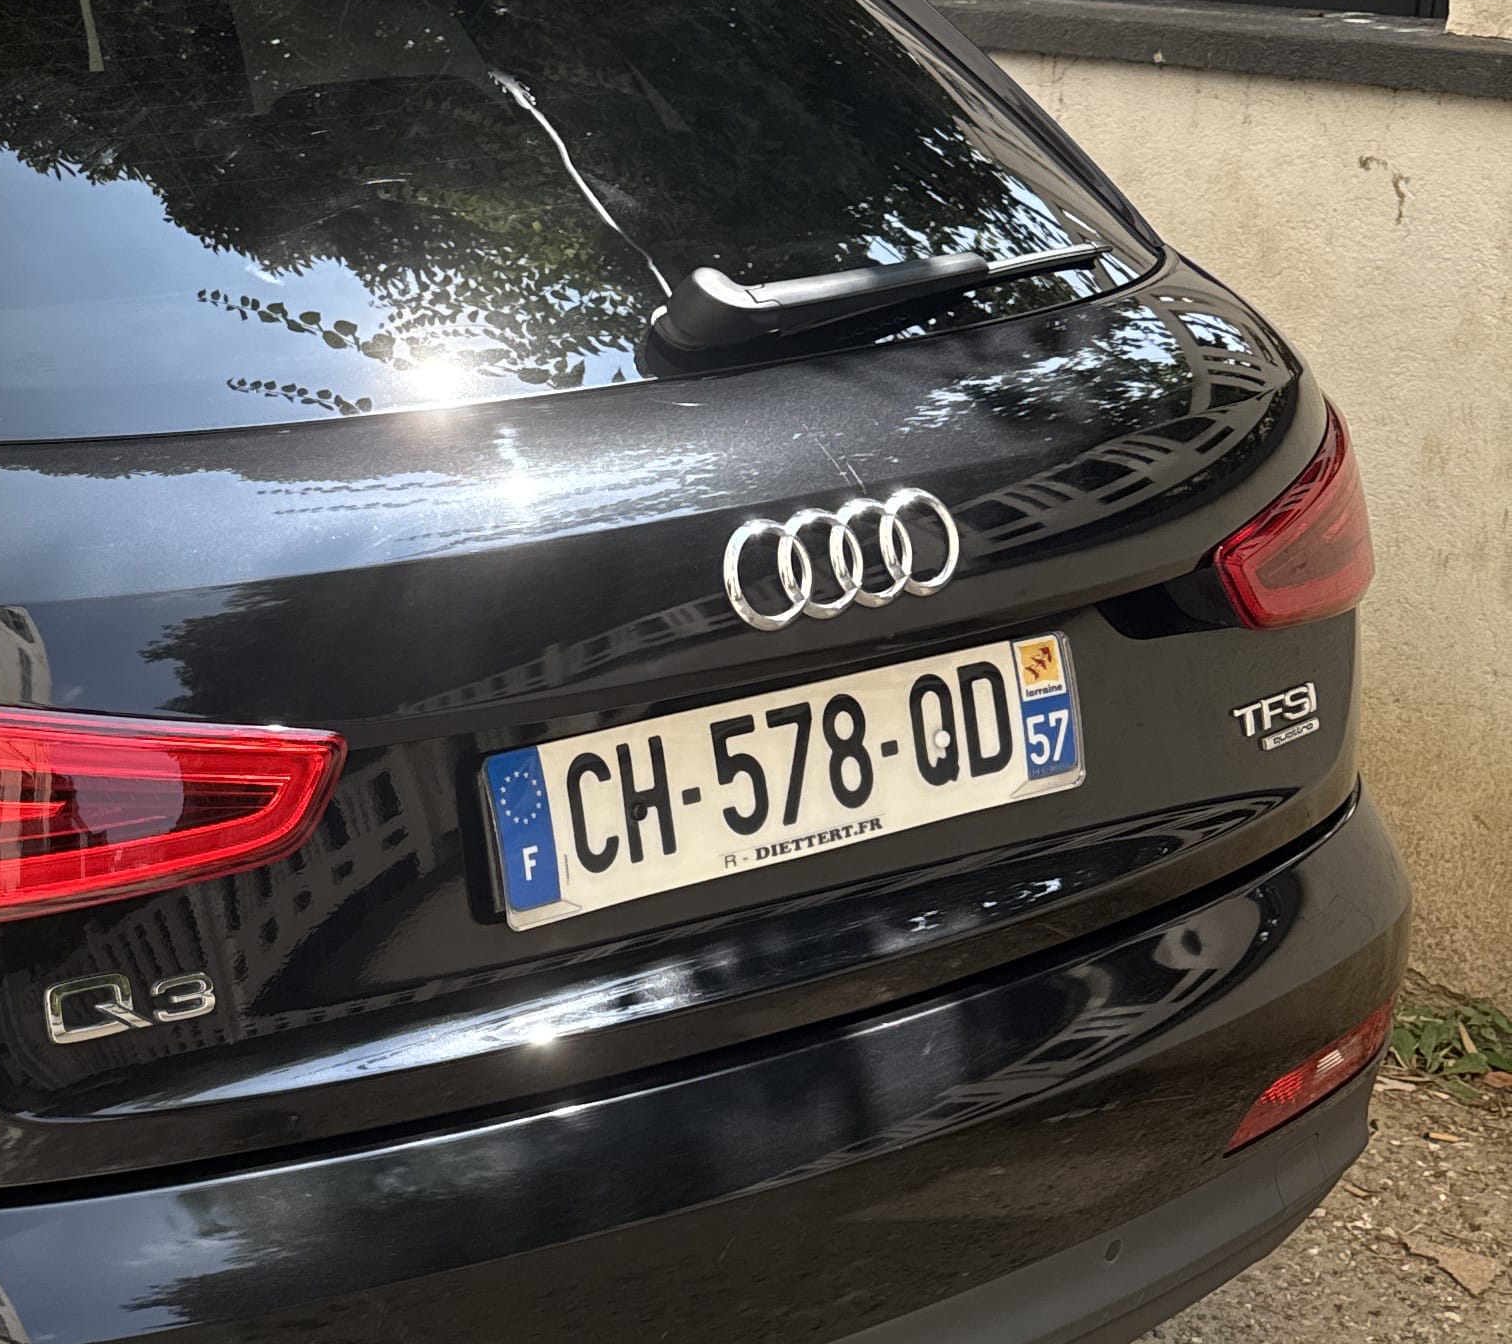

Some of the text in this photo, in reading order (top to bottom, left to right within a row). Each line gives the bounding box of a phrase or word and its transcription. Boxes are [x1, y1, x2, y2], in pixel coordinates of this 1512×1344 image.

[1026, 684, 1063, 698] lorraine
[1232, 682, 1317, 737] TFSI
[1026, 709, 1069, 765] 57
[566, 661, 1014, 874] CH-578-QD
[522, 845, 538, 881] F
[755, 818, 883, 861] DIETTERT.FR
[44, 971, 217, 1045] Q3
